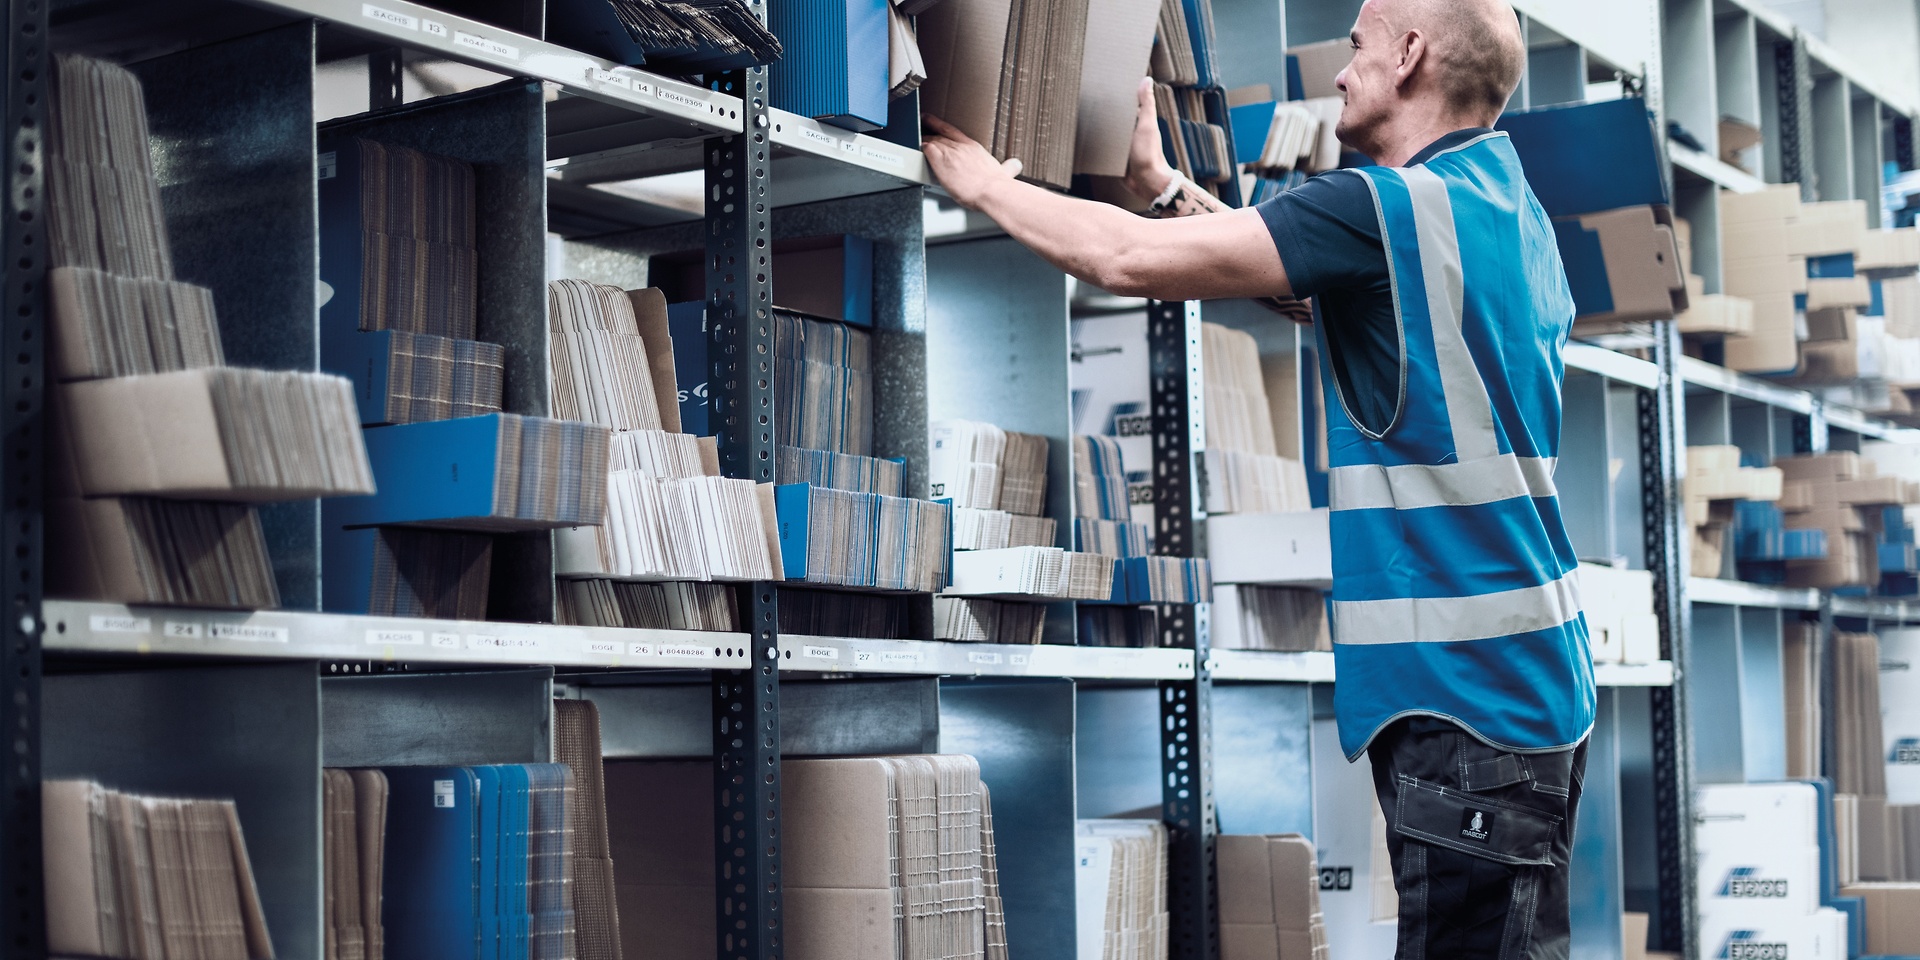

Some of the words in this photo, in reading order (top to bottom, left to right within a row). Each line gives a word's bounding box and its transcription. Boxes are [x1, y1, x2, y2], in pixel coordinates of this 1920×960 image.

[372, 9, 408, 25] SACHS
[428, 23, 440, 33] 13
[599, 72, 623, 85] GE
[638, 83, 648, 92] 14
[805, 130, 831, 144] SACHS
[846, 143, 854, 152] 15
[174, 624, 193, 635] 24
[377, 632, 413, 642] SACHS
[438, 636, 453, 645] 25
[591, 643, 615, 651] BOGE
[635, 645, 648, 654] 26
[811, 649, 831, 657] BOGE
[859, 653, 870, 661] 27
[1461, 829, 1487, 840] MASCOT
[1319, 866, 1353, 890] BO
[1732, 880, 1787, 897] BOGE
